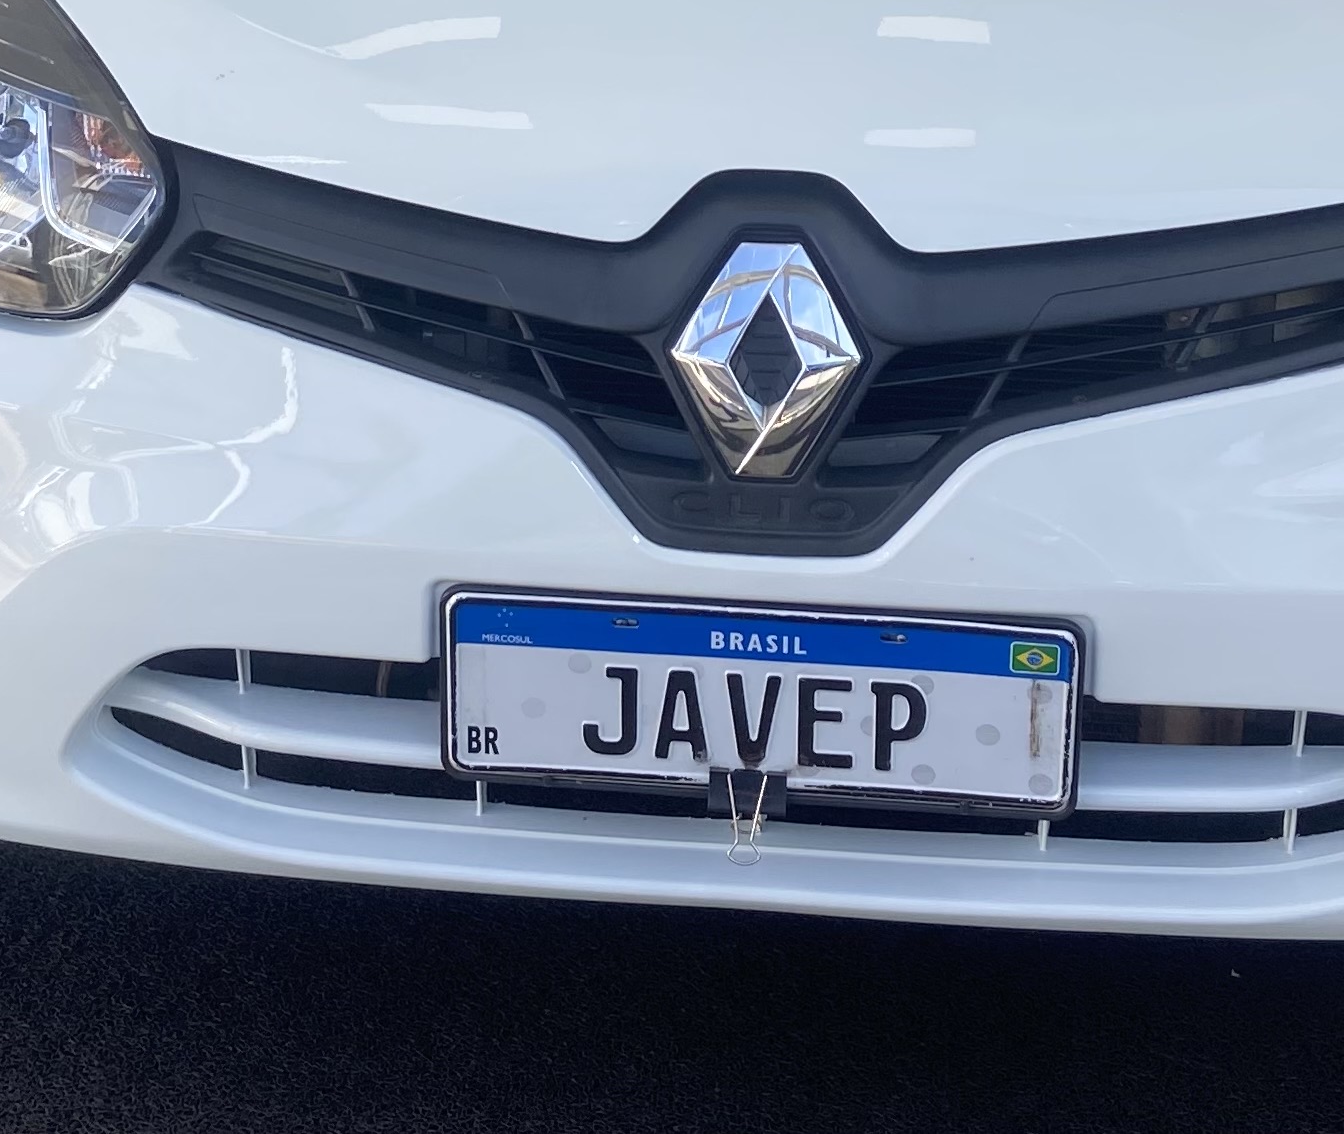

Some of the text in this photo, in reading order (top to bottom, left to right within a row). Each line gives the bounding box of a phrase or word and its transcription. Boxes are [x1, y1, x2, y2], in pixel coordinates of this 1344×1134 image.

[672, 490, 854, 523] CLIO
[482, 633, 533, 644] MERCOSUL
[709, 631, 808, 656] BRASIL
[582, 666, 928, 771] JAVEP
[466, 725, 500, 755] BR
